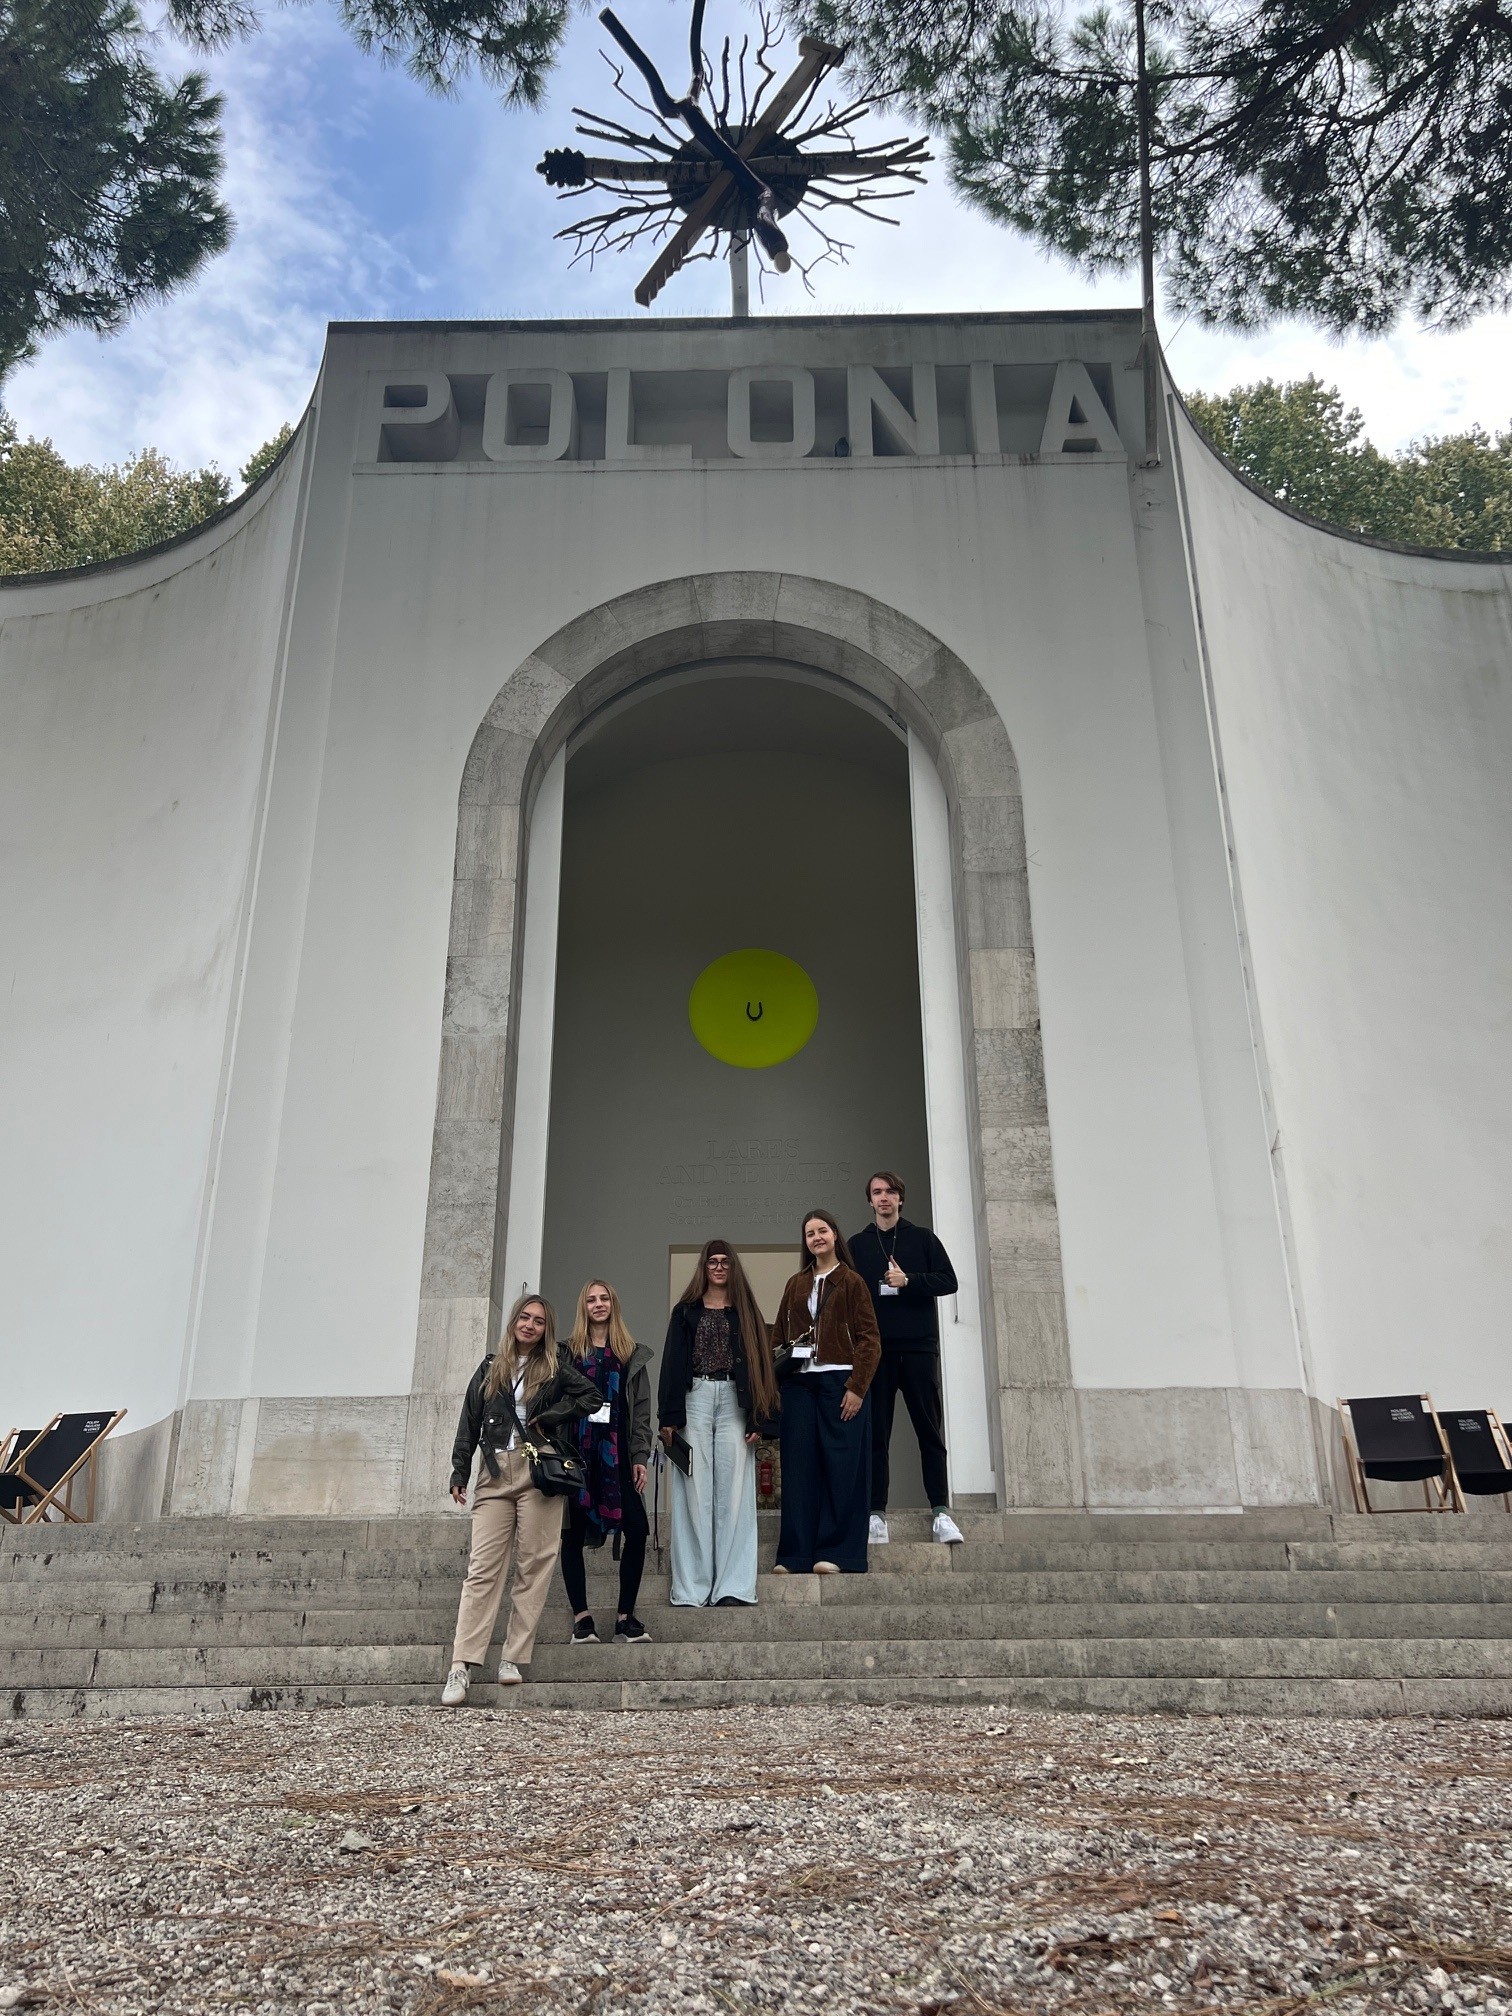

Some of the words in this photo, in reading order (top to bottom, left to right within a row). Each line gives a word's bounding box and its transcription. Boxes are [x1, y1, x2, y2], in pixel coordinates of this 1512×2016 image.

[375, 361, 1122, 463] POLONIA
[707, 1138, 801, 1159] LARES
[657, 1165, 718, 1186] AND
[725, 1161, 853, 1185] PENATES
